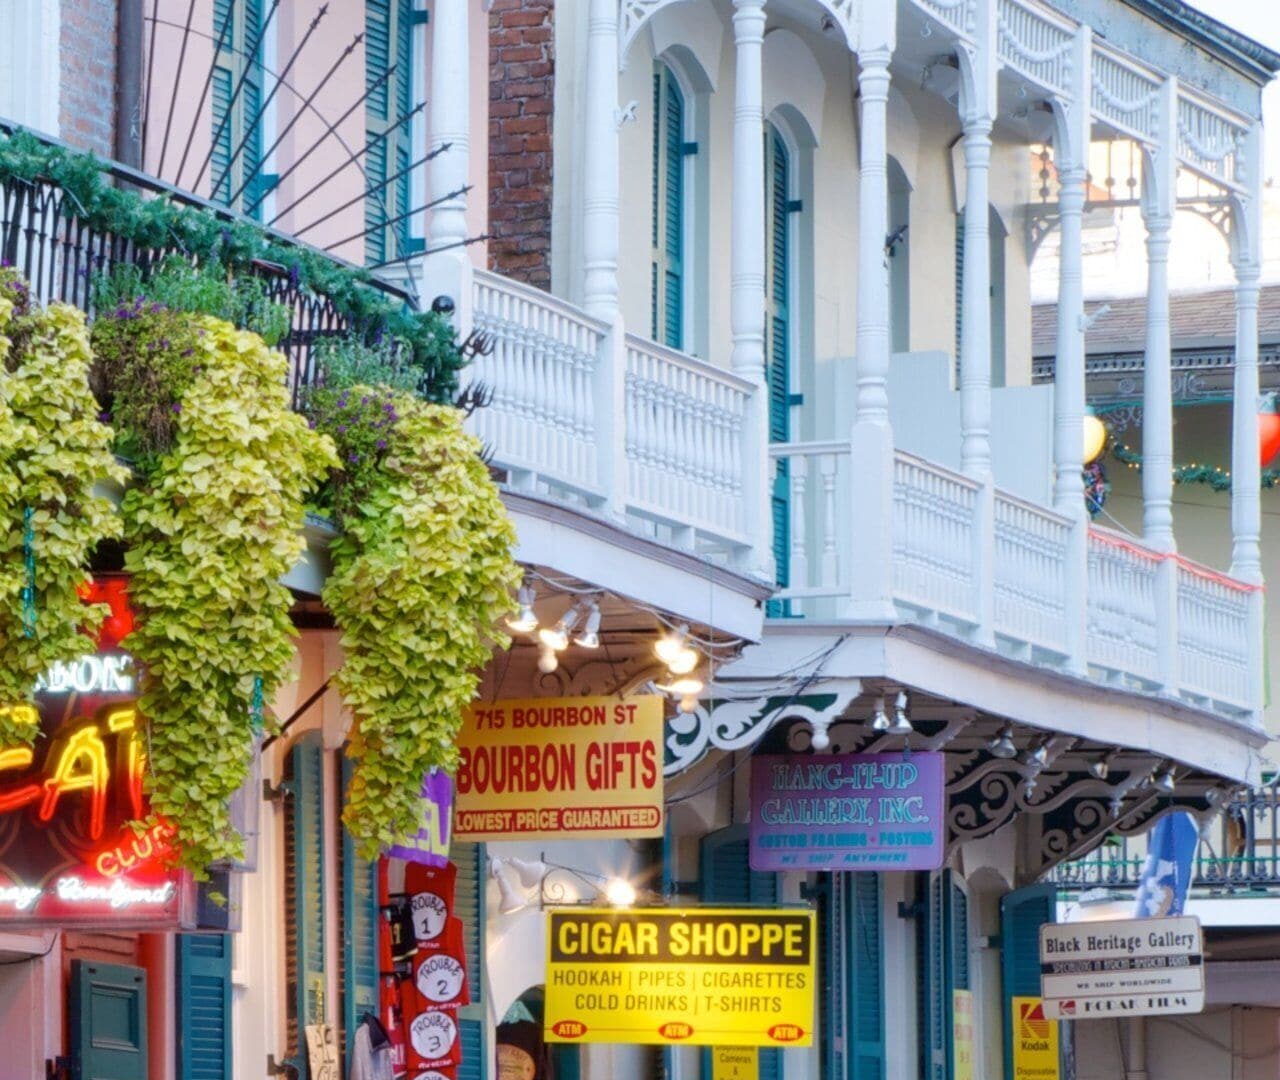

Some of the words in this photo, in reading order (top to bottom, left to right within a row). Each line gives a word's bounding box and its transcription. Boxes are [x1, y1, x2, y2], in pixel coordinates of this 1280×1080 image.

[475, 708, 505, 730] 715
[512, 705, 607, 730] BOURBON
[614, 703, 638, 726] ST
[457, 742, 577, 794] BOURBON
[585, 738, 657, 792] GIFTS
[772, 762, 918, 791] HANG-IT-UP
[456, 811, 514, 832] LOWEST
[516, 810, 559, 830] PRICE
[562, 806, 658, 829] GUARANTEED
[878, 796, 930, 824] INC.
[421, 918, 431, 934] 1
[558, 921, 659, 955] CIGAR
[669, 922, 803, 957] SHOPPE
[1045, 937, 1081, 953] Black
[1087, 933, 1142, 953] Heritage
[1148, 931, 1195, 949] Gallery
[419, 956, 460, 979] TROUBLE
[437, 980, 449, 996] 2
[553, 970, 623, 987] HOOKAH
[638, 970, 686, 988] PIPES
[702, 971, 806, 989] CIGARETTES
[575, 994, 619, 1011] COLD
[624, 994, 688, 1012] DRINKS
[705, 995, 782, 1013] T-SHIRTS
[412, 1013, 451, 1036] TROUBLE
[558, 1023, 582, 1036] ATM
[663, 1024, 689, 1037] ATM
[772, 1025, 799, 1039] ATM
[428, 1036, 442, 1053] 3
